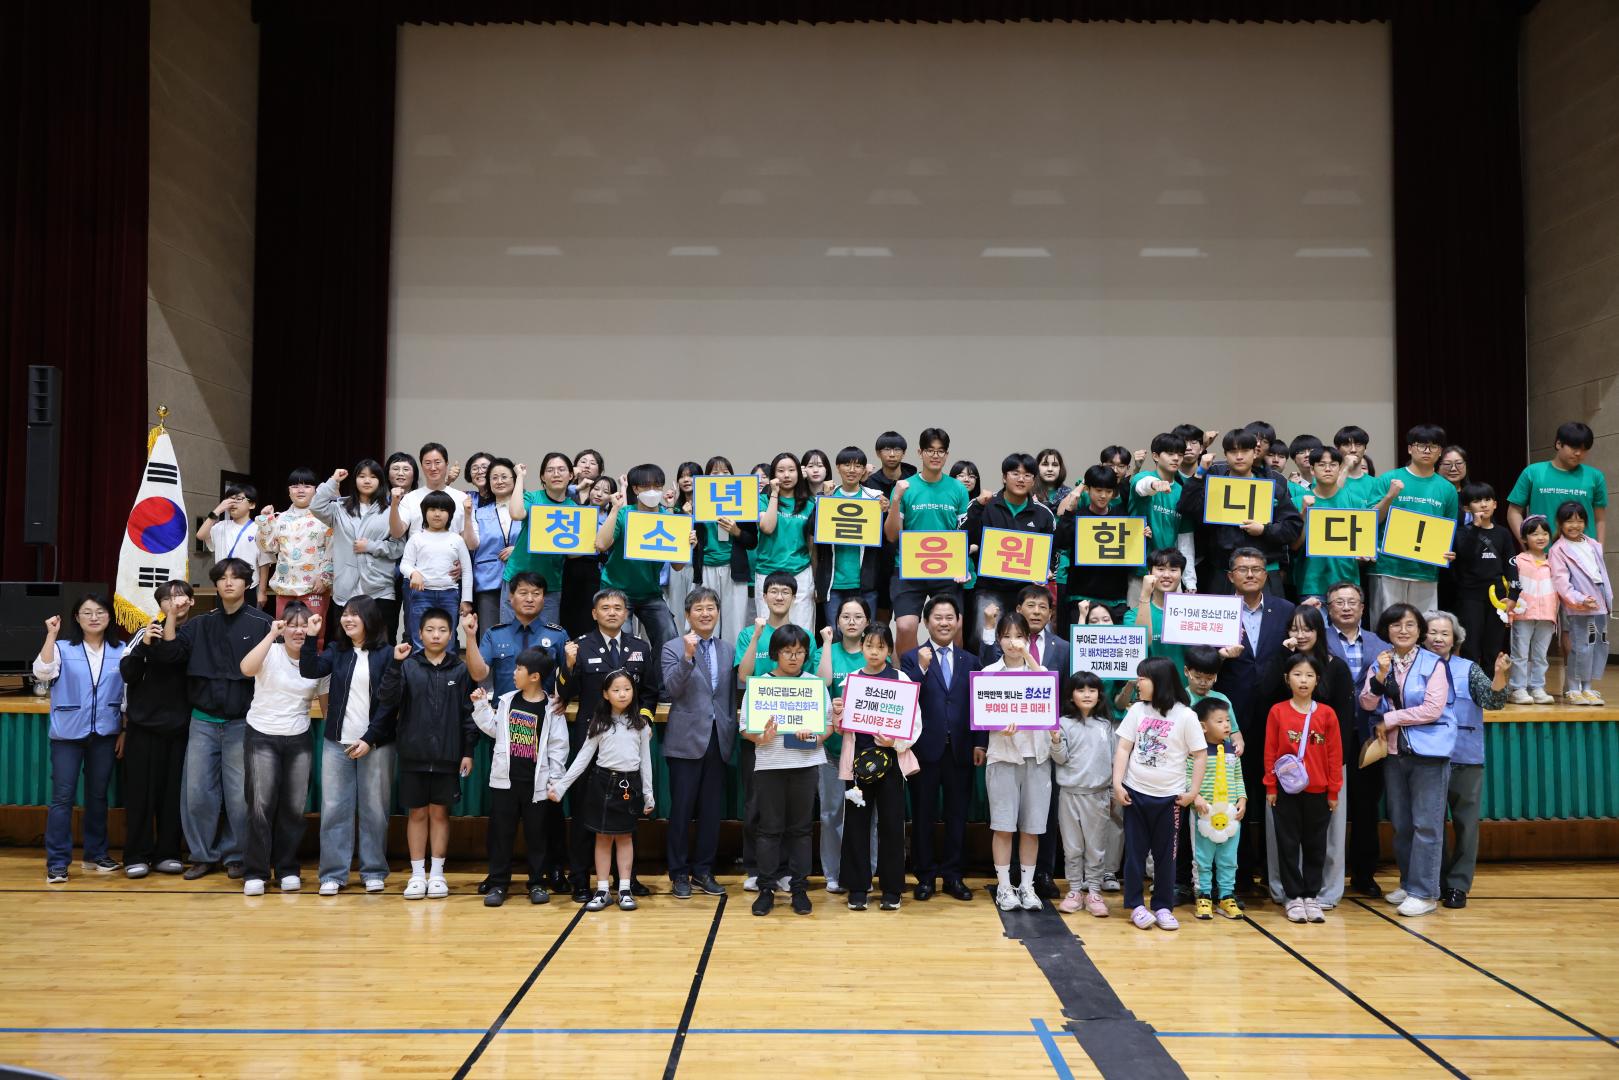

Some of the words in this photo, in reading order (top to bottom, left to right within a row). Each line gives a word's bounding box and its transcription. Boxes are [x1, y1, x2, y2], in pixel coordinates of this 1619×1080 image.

[709, 480, 743, 517] 년
[1218, 484, 1257, 524] 니
[545, 509, 581, 549] 청
[830, 502, 868, 540] 을
[639, 520, 678, 552] 소
[1092, 521, 1131, 560] 합
[1324, 514, 1363, 552] 다
[1413, 519, 1427, 553] !
[915, 536, 953, 574] 응
[996, 536, 1034, 575] 원
[1201, 608, 1222, 620] 청소년
[1223, 610, 1238, 620] 대상
[1180, 620, 1208, 632] 금융교육
[1208, 622, 1224, 632] 지원
[1076, 634, 1098, 644] 부여군
[1098, 634, 1127, 644] 버스노선
[1128, 635, 1142, 644] 정비
[1080, 648, 1087, 657] 및
[1088, 648, 1124, 658] 배차변경을
[1124, 648, 1140, 658] 위한
[1090, 661, 1112, 671] 지자체
[1114, 661, 1128, 671] 지원
[758, 686, 812, 698] 부여군립도서관
[865, 686, 896, 700] 청소년이
[978, 690, 1002, 700] 반짝반짝
[1004, 690, 1023, 700] 빛나는
[1025, 687, 1052, 699] 청소년
[754, 700, 778, 710] 청소년
[780, 701, 818, 711] 학습친화적
[855, 699, 879, 712] 걷기에
[880, 702, 904, 715] 안전한
[986, 703, 1008, 712] 부여의
[1010, 704, 1018, 712] 더
[1020, 704, 1028, 712] 큰
[1030, 704, 1046, 712] 미래
[788, 714, 803, 724] 마련
[852, 712, 884, 727] 도시야경
[886, 718, 902, 729] 조성
